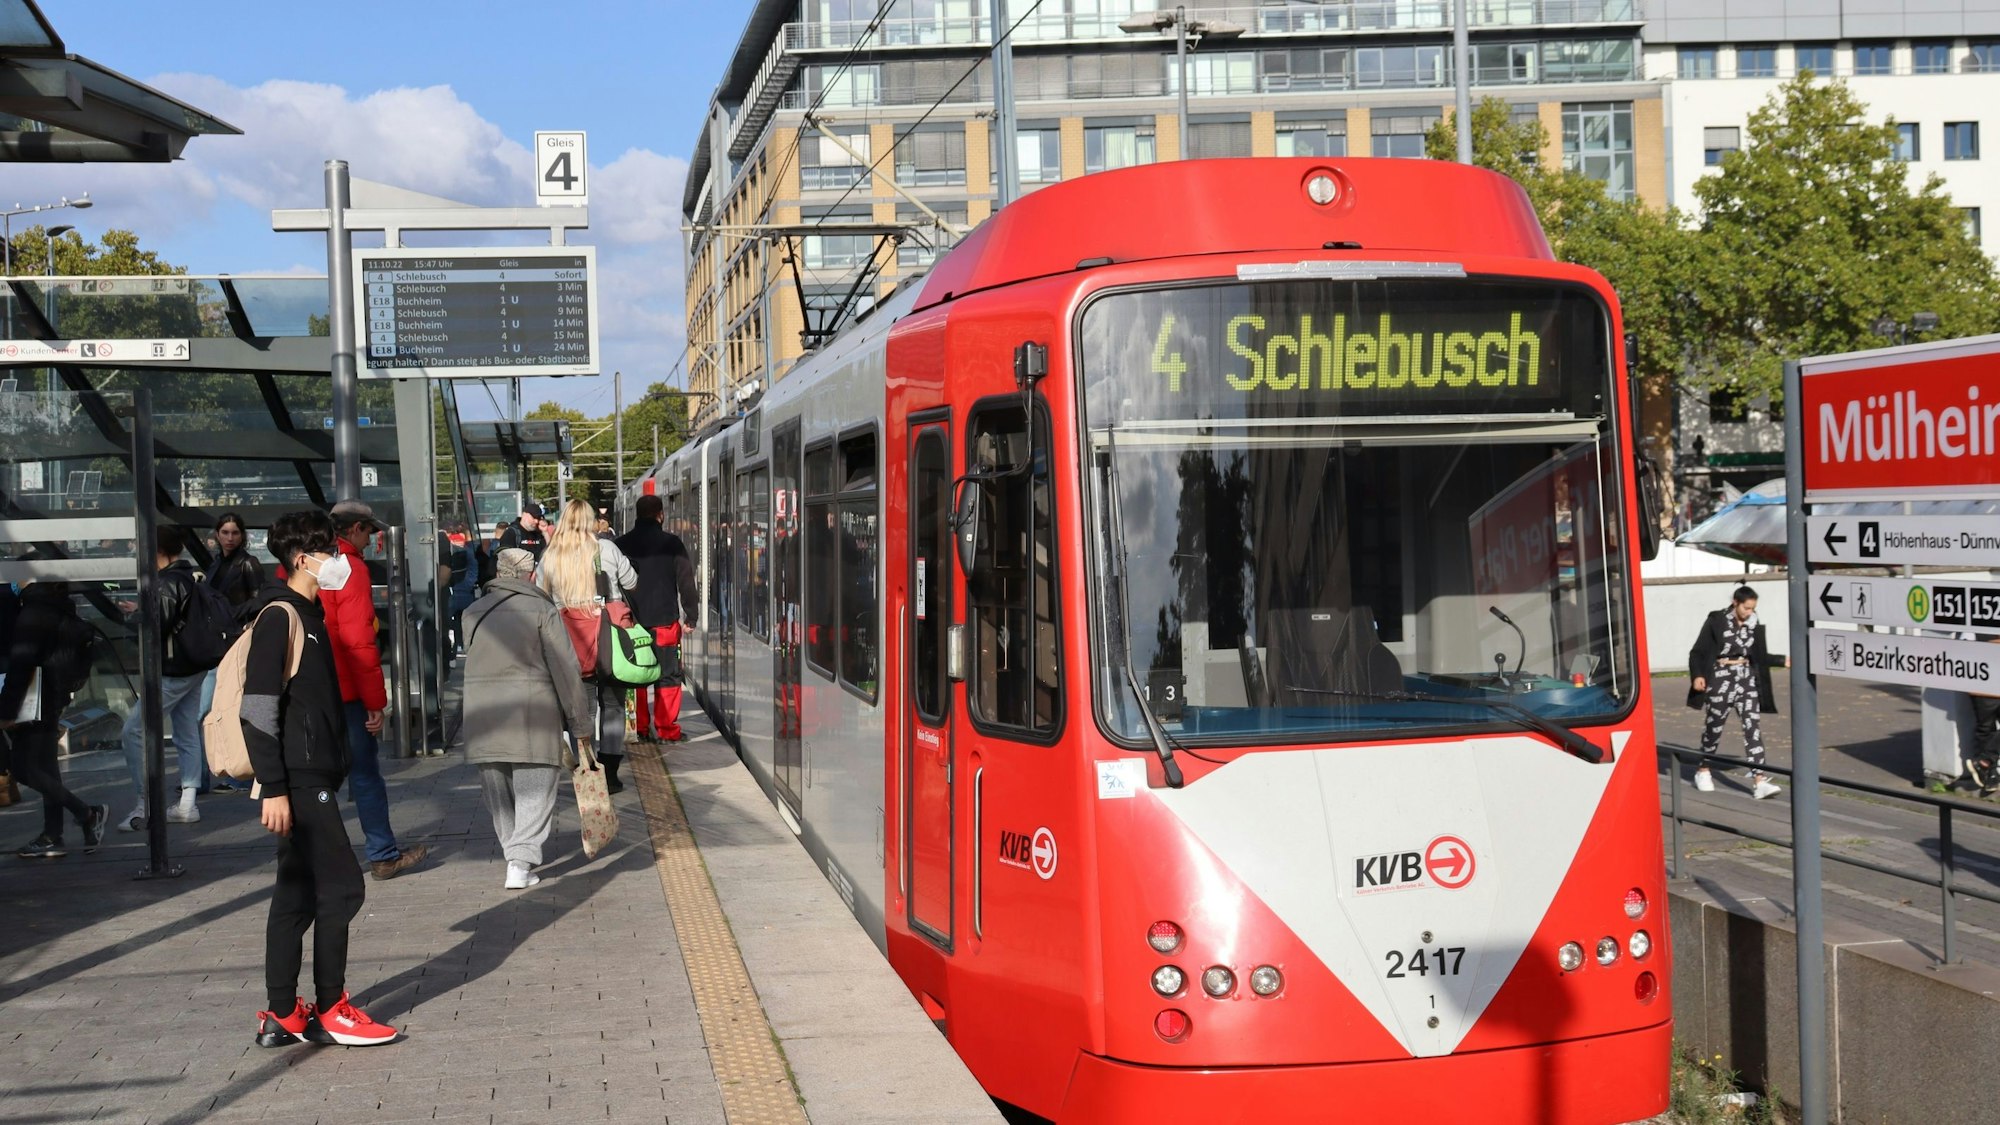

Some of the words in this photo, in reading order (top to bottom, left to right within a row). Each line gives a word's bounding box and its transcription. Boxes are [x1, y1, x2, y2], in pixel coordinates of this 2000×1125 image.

[547, 137, 574, 147] Gleis
[545, 152, 578, 190] 4
[396, 272, 446, 280] Schlebusch
[554, 270, 582, 279] Sofort
[396, 284, 446, 293] Schlebusch
[500, 284, 505, 292] 4
[565, 282, 582, 291] Min
[397, 297, 442, 306] Buchheim
[501, 296, 506, 304] 1
[511, 296, 519, 304] U
[566, 294, 583, 303] Min
[397, 309, 447, 318] Schlebusch
[500, 308, 506, 316] 4
[558, 307, 563, 315] 9
[566, 306, 583, 315] Min
[398, 321, 442, 329] Buchheim
[512, 320, 520, 328] U
[554, 319, 564, 327] 14
[566, 319, 584, 327] Min
[399, 333, 448, 342] Schlebusch
[501, 332, 507, 340] 4
[554, 331, 564, 340] 15
[567, 331, 584, 339] Min
[400, 346, 443, 354] Buchheim
[513, 344, 520, 352] U
[554, 343, 564, 351] 24
[567, 343, 584, 351] Min
[1151, 316, 1187, 392] 4
[1226, 311, 1541, 391] Schlebusch
[396, 358, 428, 366] halten?
[457, 356, 478, 366] steig
[480, 356, 492, 365] als
[494, 356, 513, 365] Bus-
[515, 355, 535, 364] oder
[366, 472, 372, 483] 3
[563, 466, 570, 477] 4
[1862, 527, 1876, 553] 4
[1884, 532, 1951, 549] Höhenhaus
[1934, 593, 1965, 618] 151
[1971, 595, 2000, 620] 152
[1853, 643, 1990, 681] Bezirksrathaus
[1166, 685, 1175, 701] 3
[1000, 830, 1031, 862] KVB
[1356, 852, 1422, 888] KVB
[1385, 947, 1466, 978] 2417
[1429, 994, 1435, 1009] 1
